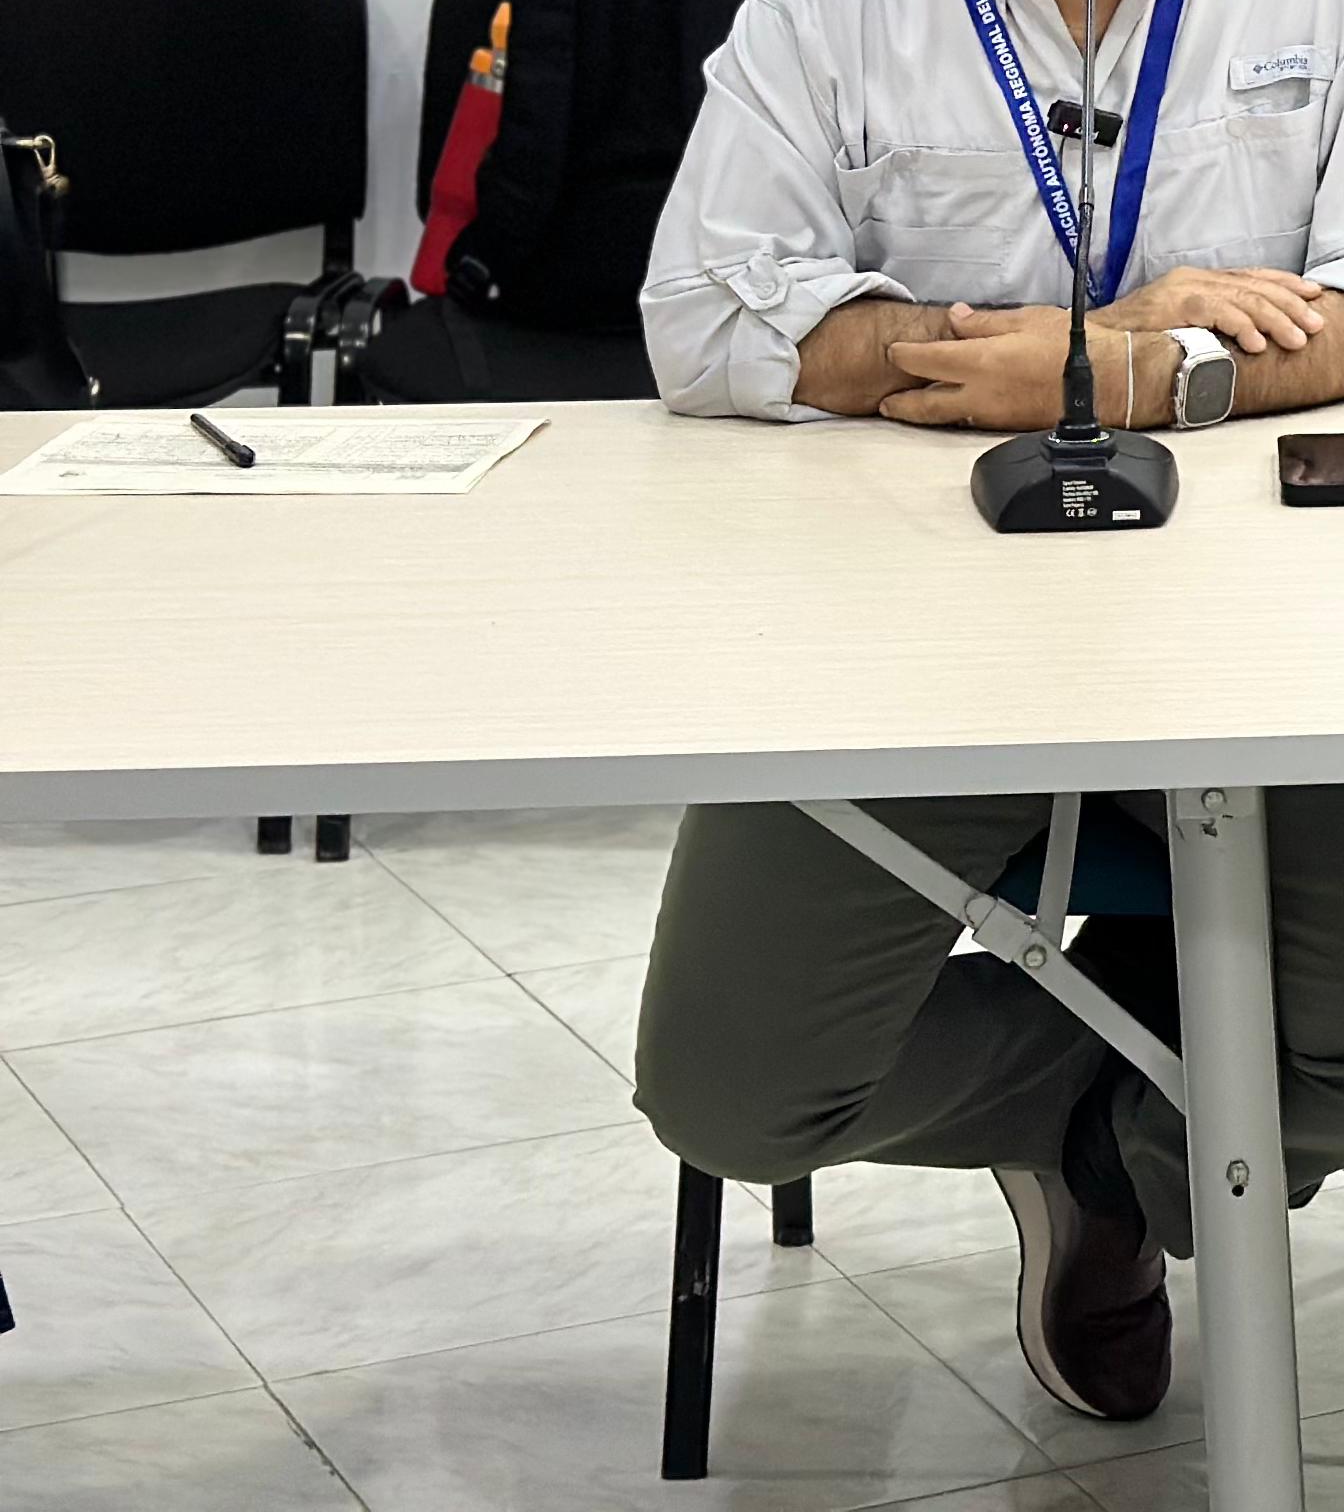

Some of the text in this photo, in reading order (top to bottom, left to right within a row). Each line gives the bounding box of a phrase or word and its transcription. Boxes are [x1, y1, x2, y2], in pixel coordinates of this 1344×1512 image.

[988, 24, 1028, 100] REGIONAL
[1264, 54, 1308, 71] Columbia
[1019, 100, 1061, 186] AUTÓNOMA
